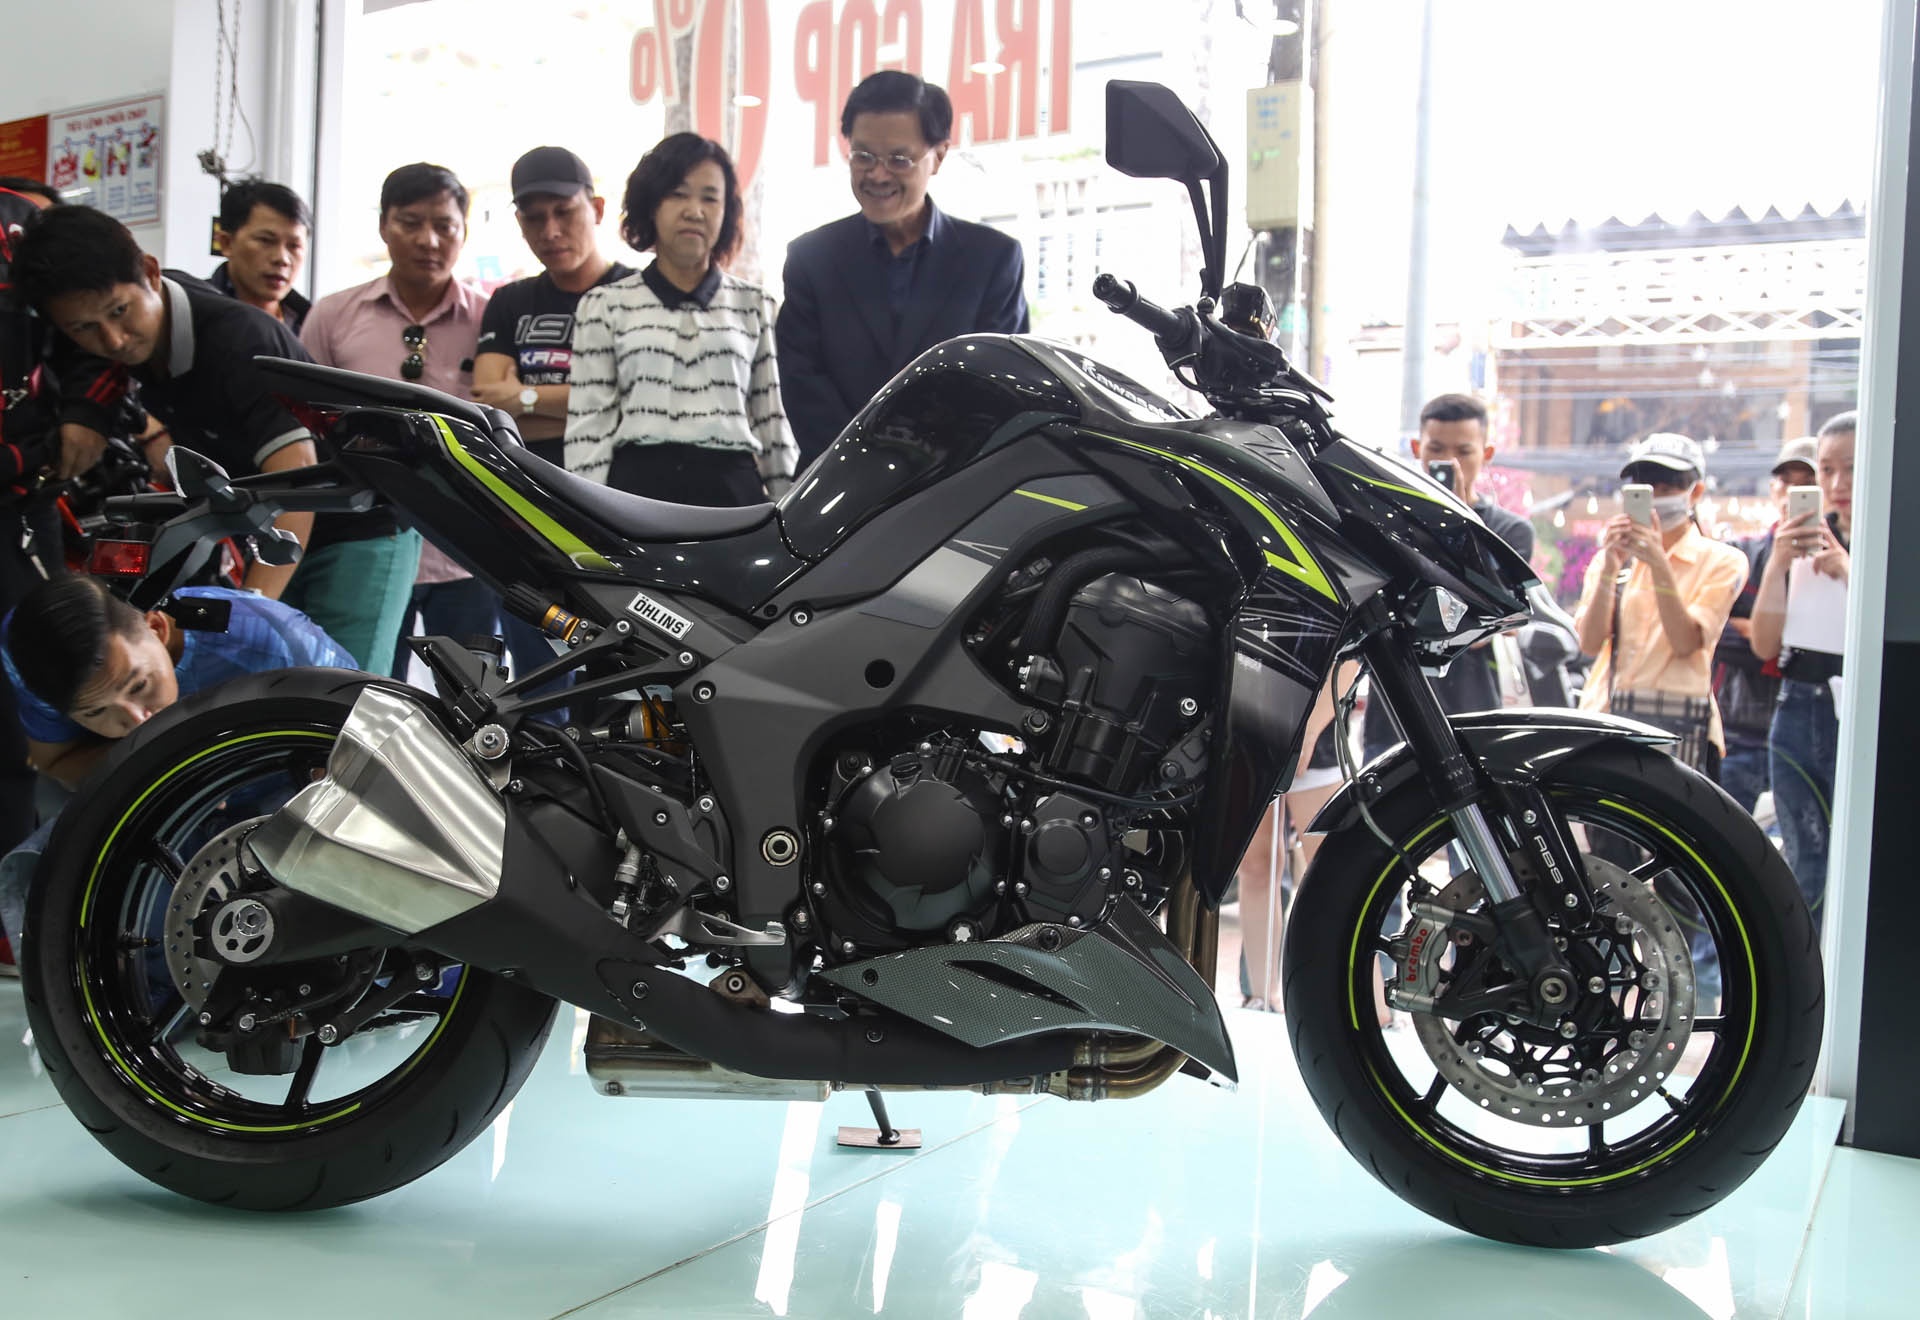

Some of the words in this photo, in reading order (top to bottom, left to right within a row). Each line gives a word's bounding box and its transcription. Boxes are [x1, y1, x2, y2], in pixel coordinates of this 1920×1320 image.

[634, 596, 685, 635] ÖHLINS
[1534, 835, 1564, 884] ABS
[1406, 928, 1428, 983] brembo
